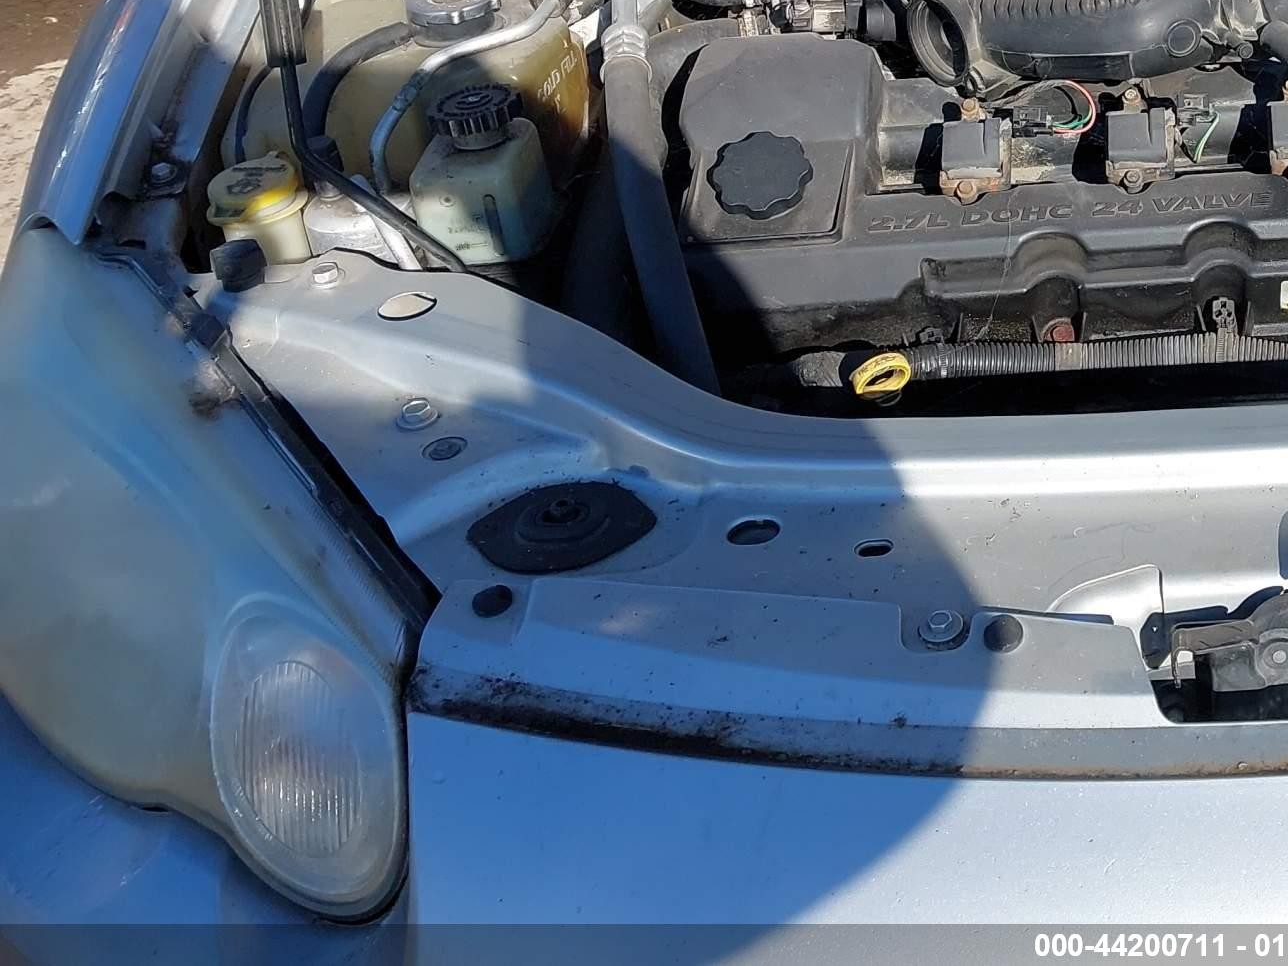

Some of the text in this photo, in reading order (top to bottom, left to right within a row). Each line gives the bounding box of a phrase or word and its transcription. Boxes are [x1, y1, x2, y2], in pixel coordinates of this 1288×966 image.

[867, 191, 1273, 232] 2.7L DOHC 24 VALVE
